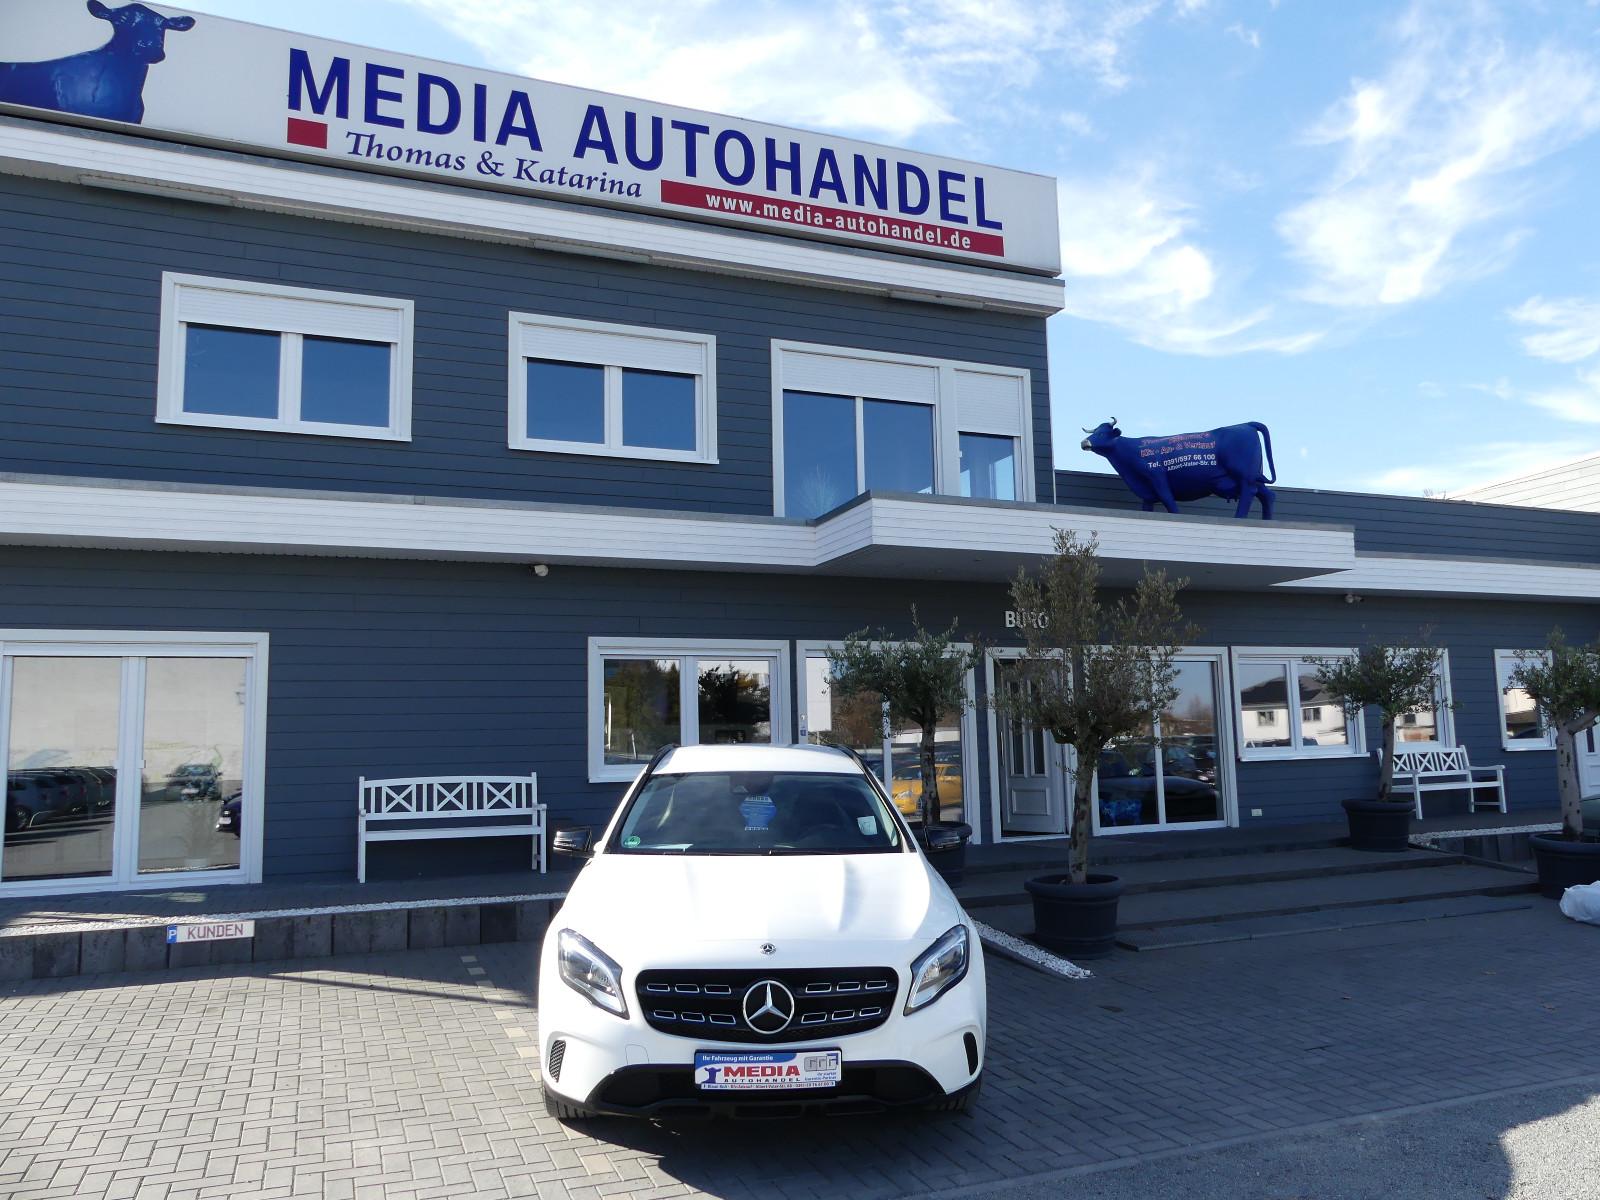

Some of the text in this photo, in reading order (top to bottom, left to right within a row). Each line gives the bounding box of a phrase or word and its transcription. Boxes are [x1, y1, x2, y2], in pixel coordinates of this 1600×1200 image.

[288, 48, 1003, 230] MEDIA AUTOHANDEL
[345, 131, 642, 198] Thomas & Katarina
[705, 192, 972, 249] www.media-autohandel.de
[1148, 461, 1161, 469] Tel.
[187, 923, 244, 940] KUNDEN
[711, 1055, 738, 1063] Fahrzeug
[748, 1054, 774, 1062] Garantie
[723, 1065, 800, 1078] MEDIA
